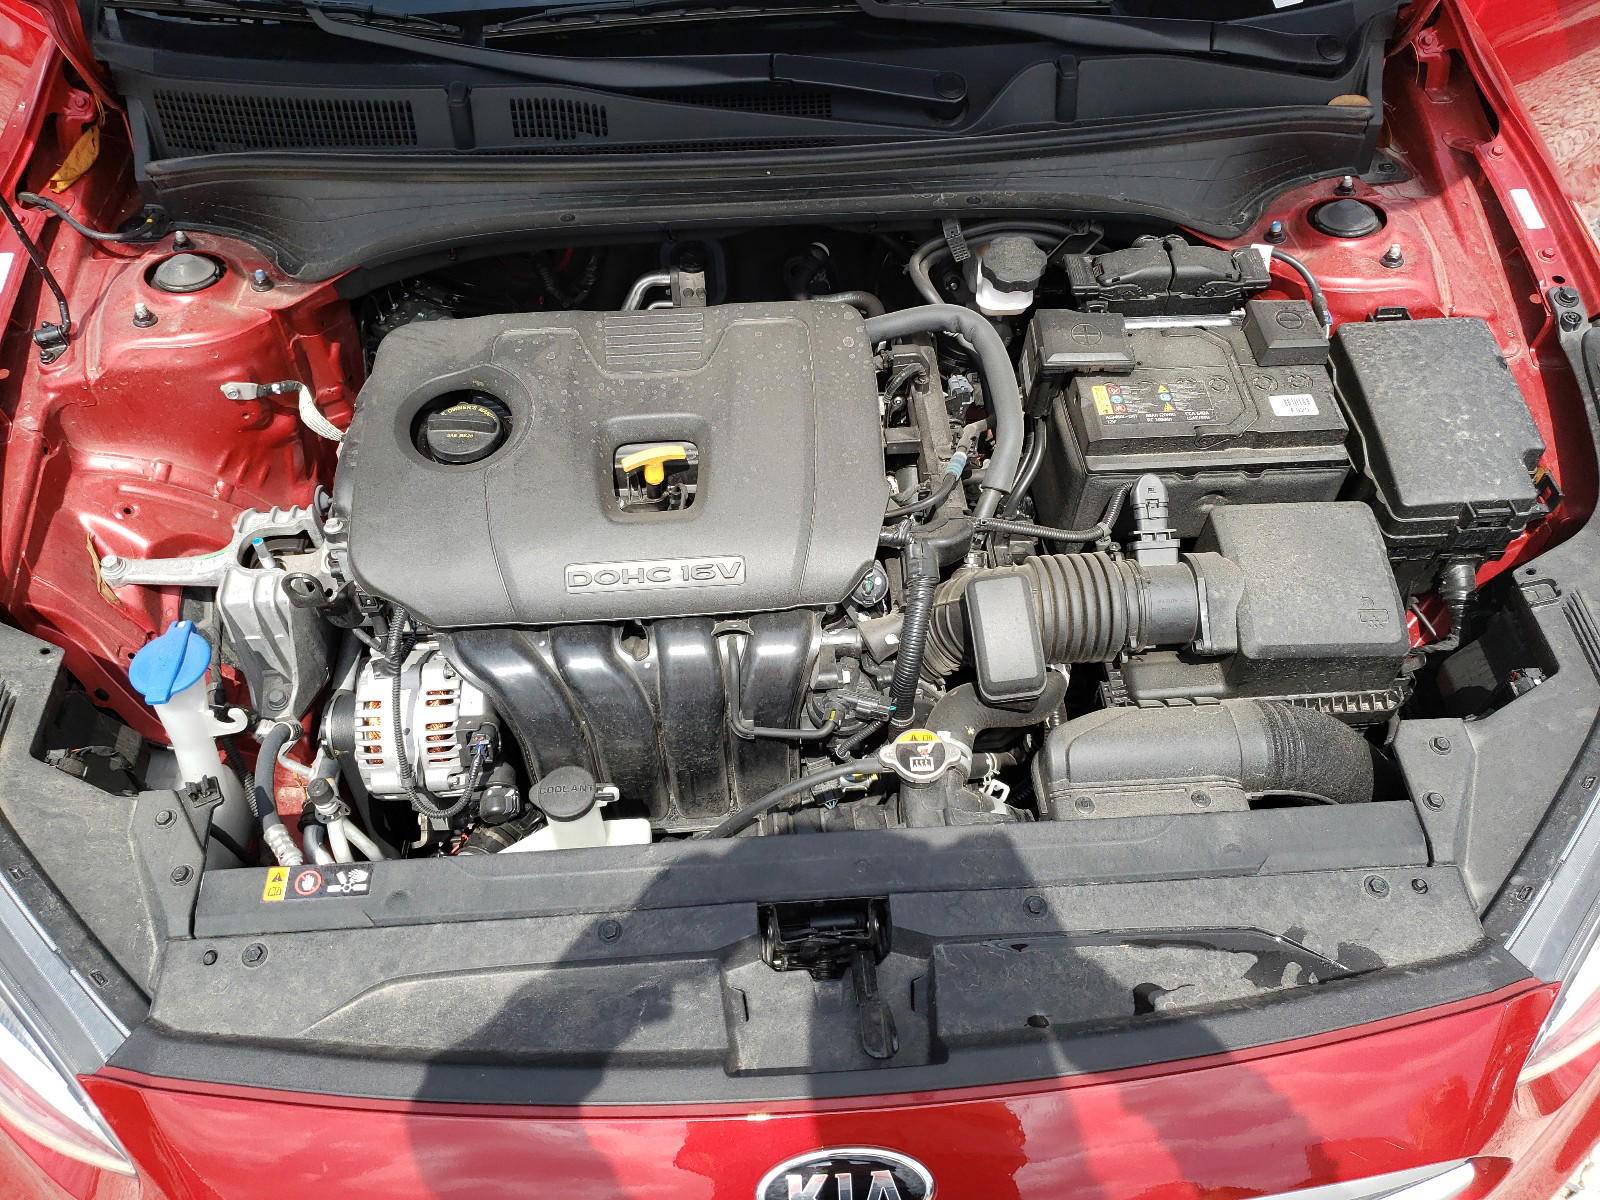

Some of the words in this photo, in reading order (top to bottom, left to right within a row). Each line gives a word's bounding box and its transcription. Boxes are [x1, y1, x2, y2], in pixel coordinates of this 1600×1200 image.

[567, 566, 672, 588] DOHC
[680, 561, 742, 582] 16V
[539, 784, 594, 795] COOLANT
[785, 1169, 903, 1200] KIA
